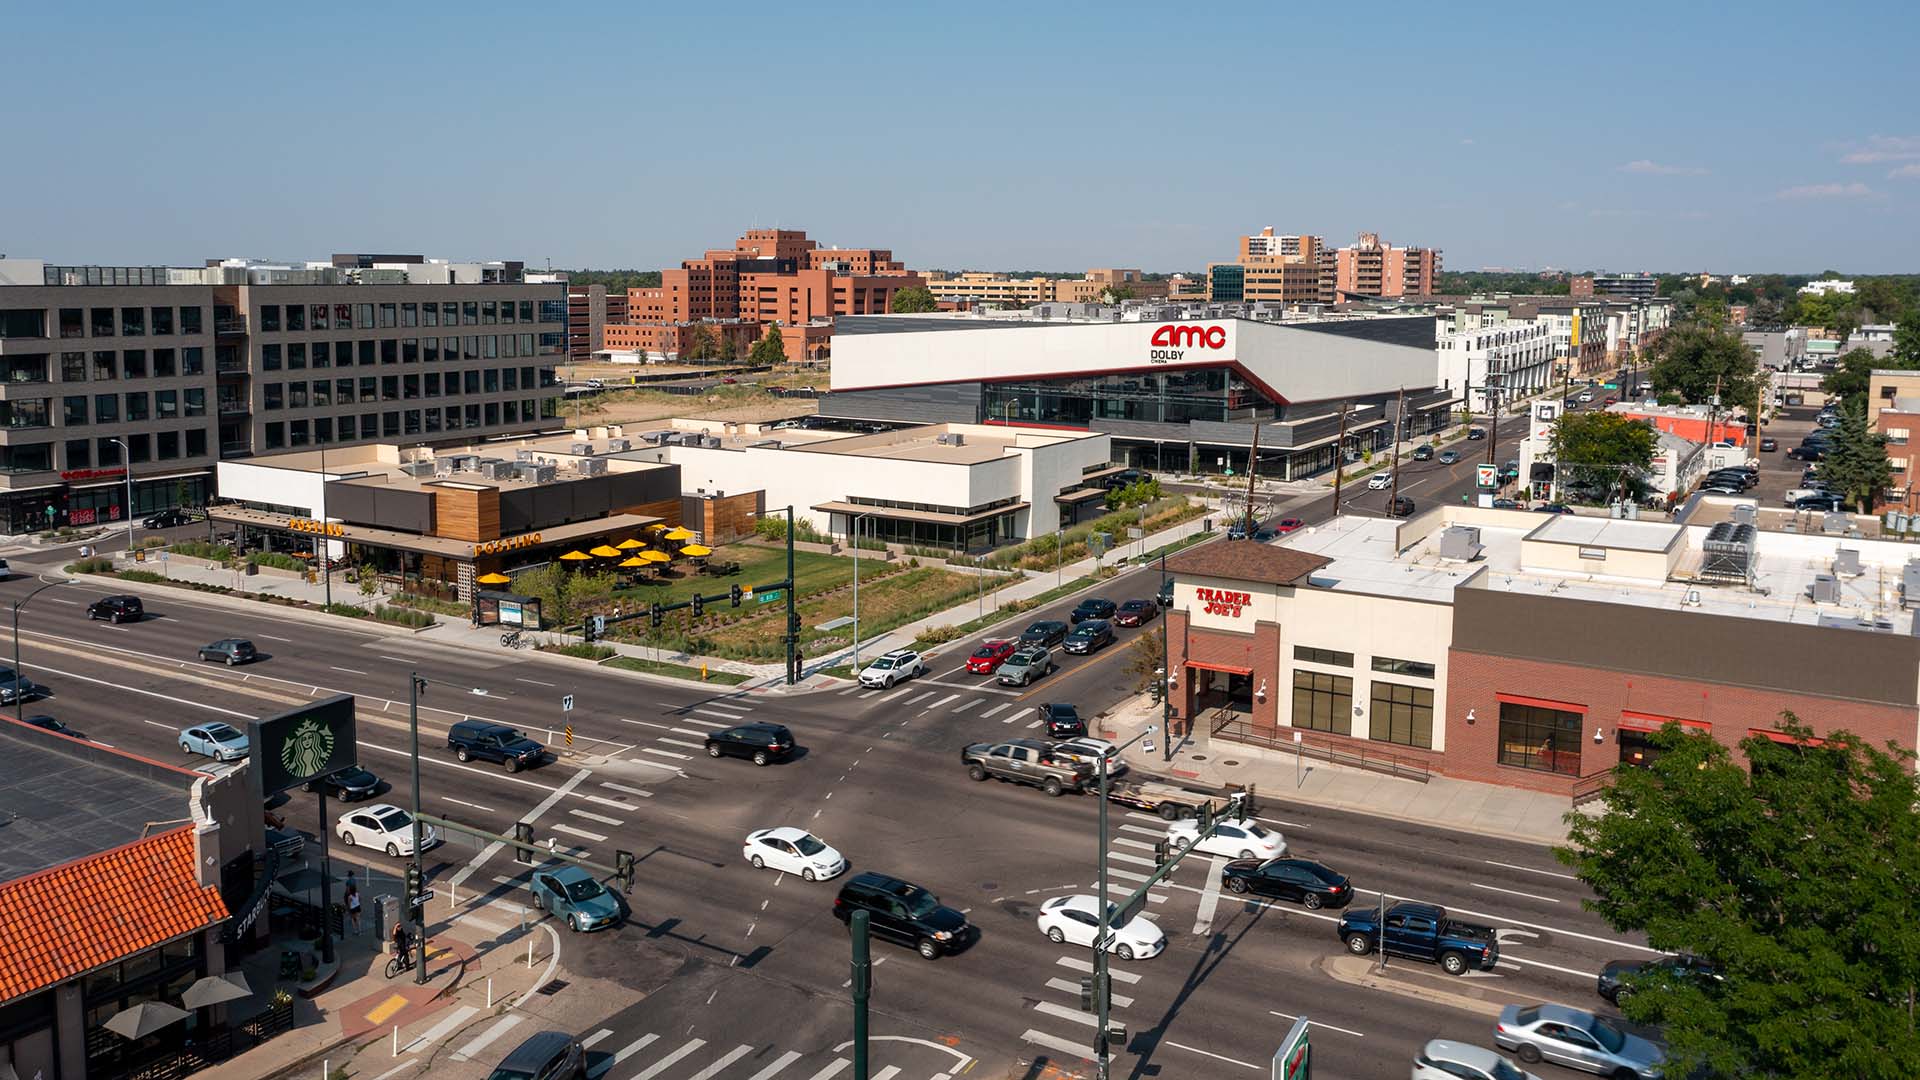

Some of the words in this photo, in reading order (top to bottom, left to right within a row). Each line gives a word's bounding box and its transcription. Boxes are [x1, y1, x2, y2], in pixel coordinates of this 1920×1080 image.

[1151, 350, 1184, 360] DOLBY
[289, 518, 344, 537] POSTINO
[474, 532, 543, 557] POSTINO
[1196, 588, 1252, 606] TRADER
[1203, 601, 1242, 618] JOE'S
